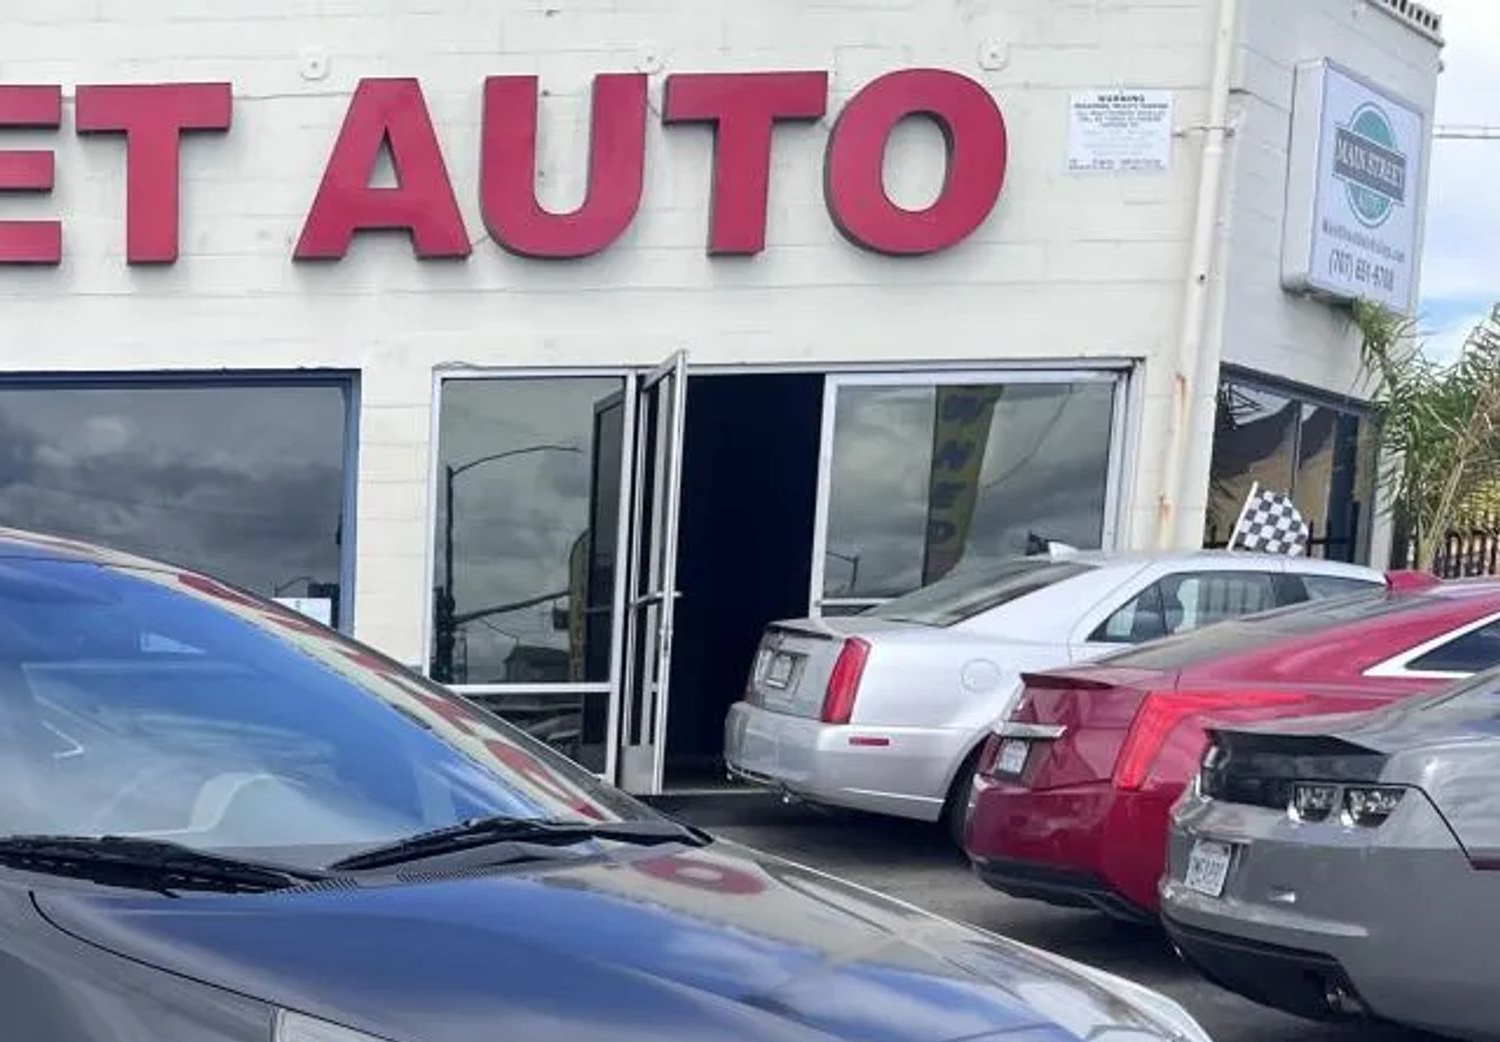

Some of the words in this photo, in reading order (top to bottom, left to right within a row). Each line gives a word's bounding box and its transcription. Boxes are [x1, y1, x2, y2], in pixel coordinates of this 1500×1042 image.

[292, 68, 1008, 259] AUTO
[1336, 137, 1366, 170] MAIN
[1365, 149, 1404, 188] STREET
